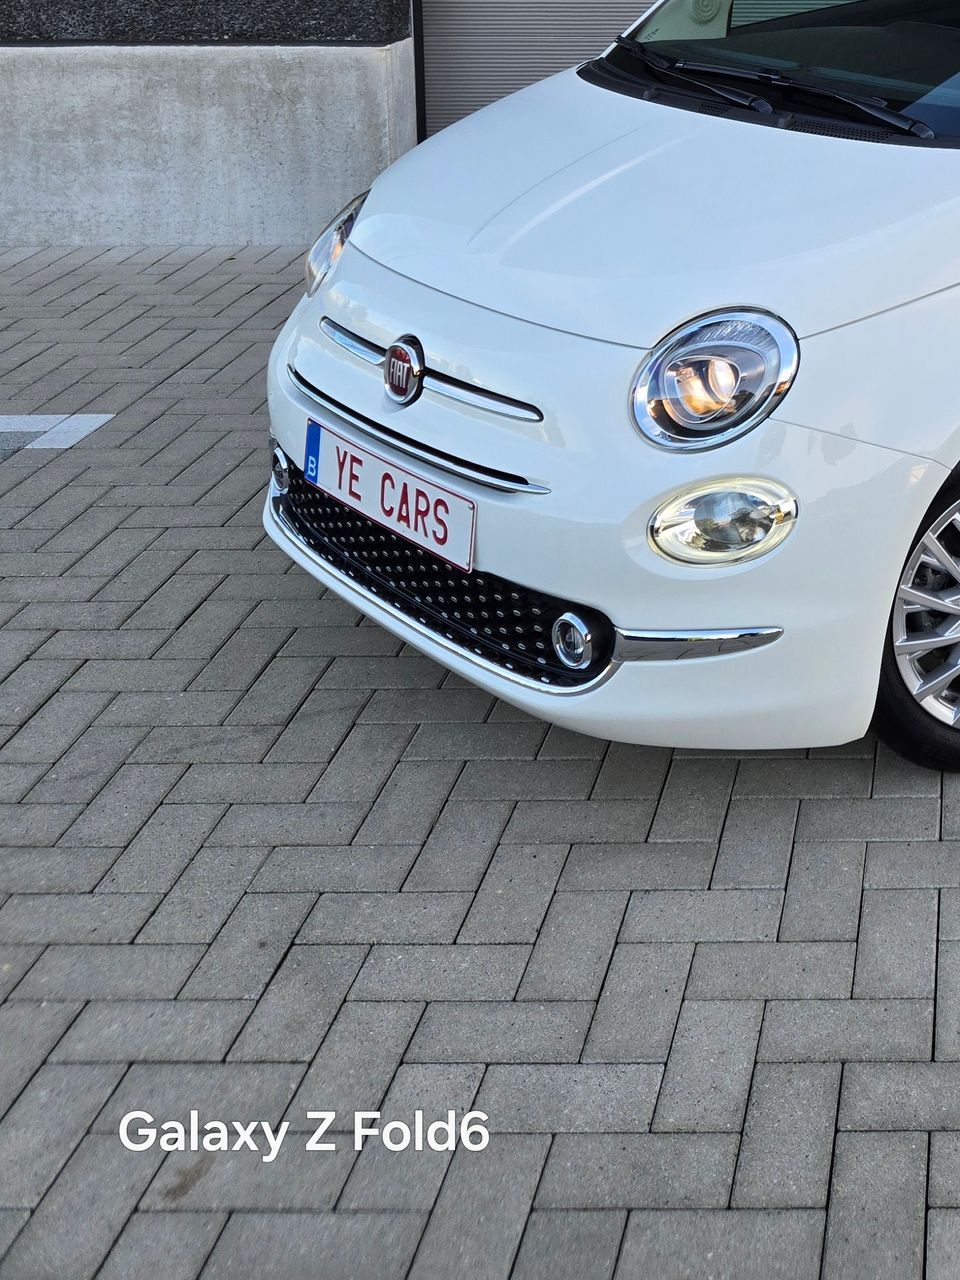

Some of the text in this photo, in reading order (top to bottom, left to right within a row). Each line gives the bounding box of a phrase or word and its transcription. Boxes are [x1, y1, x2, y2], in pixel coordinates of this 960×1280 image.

[389, 357, 411, 389] FIAT
[307, 455, 317, 477] B
[335, 445, 449, 546] YE CARS
